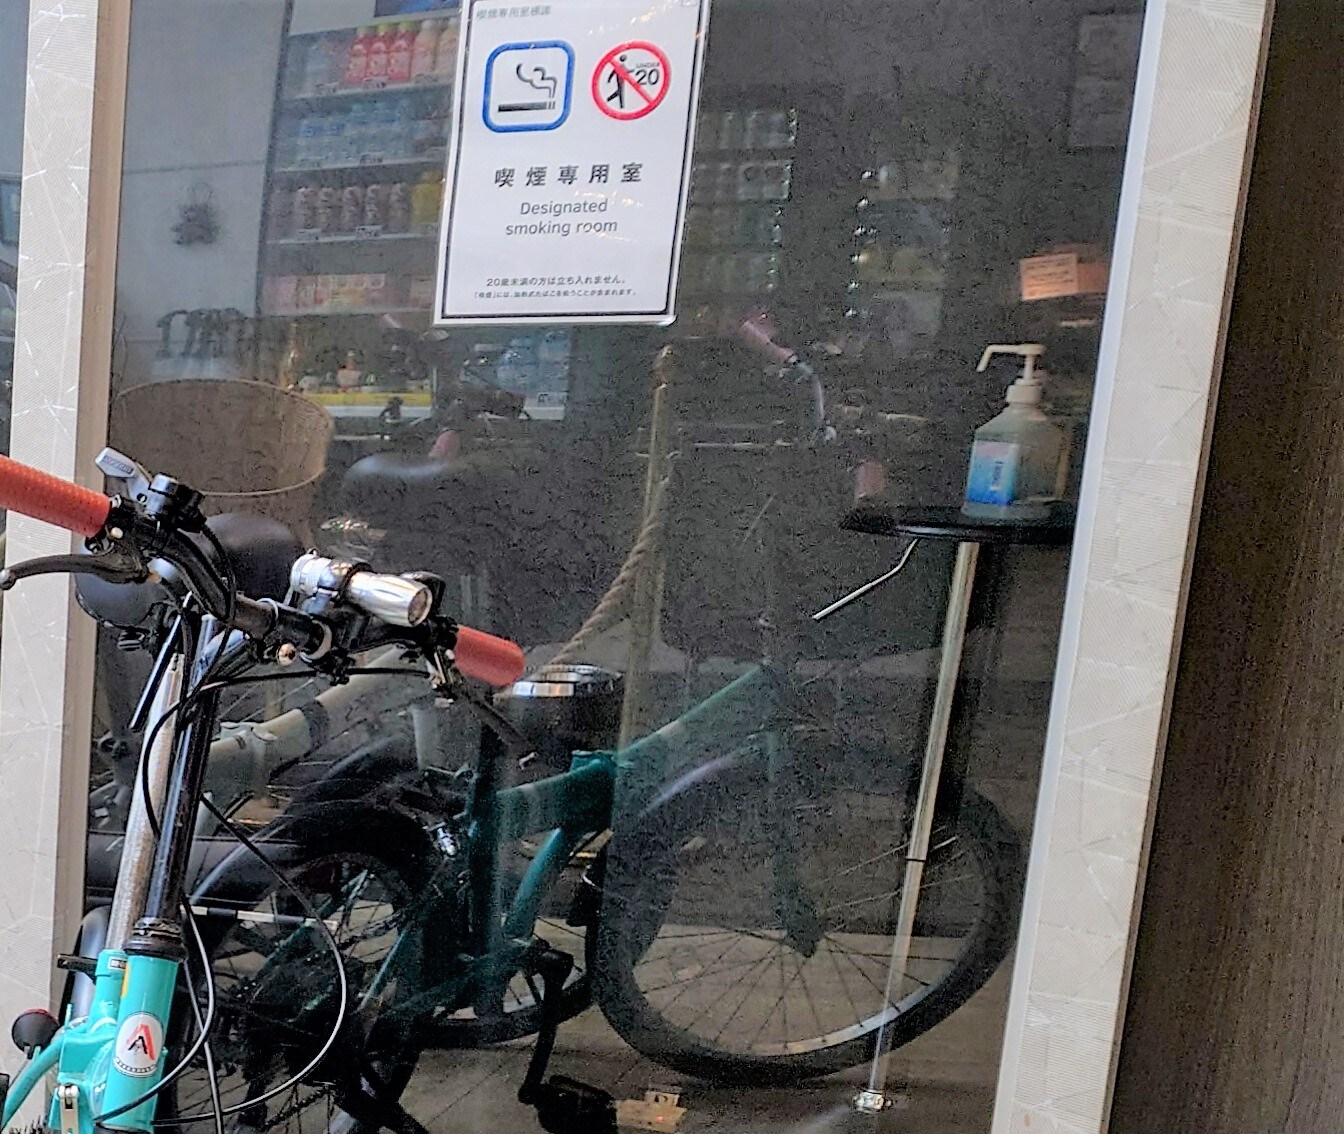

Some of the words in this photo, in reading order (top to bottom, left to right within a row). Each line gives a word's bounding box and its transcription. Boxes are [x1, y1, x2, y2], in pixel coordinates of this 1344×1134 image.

[635, 69, 659, 85] 20
[494, 162, 643, 188] 喫煙専用室
[520, 198, 609, 217] Designated
[506, 220, 571, 237] smoking
[576, 221, 618, 234] room
